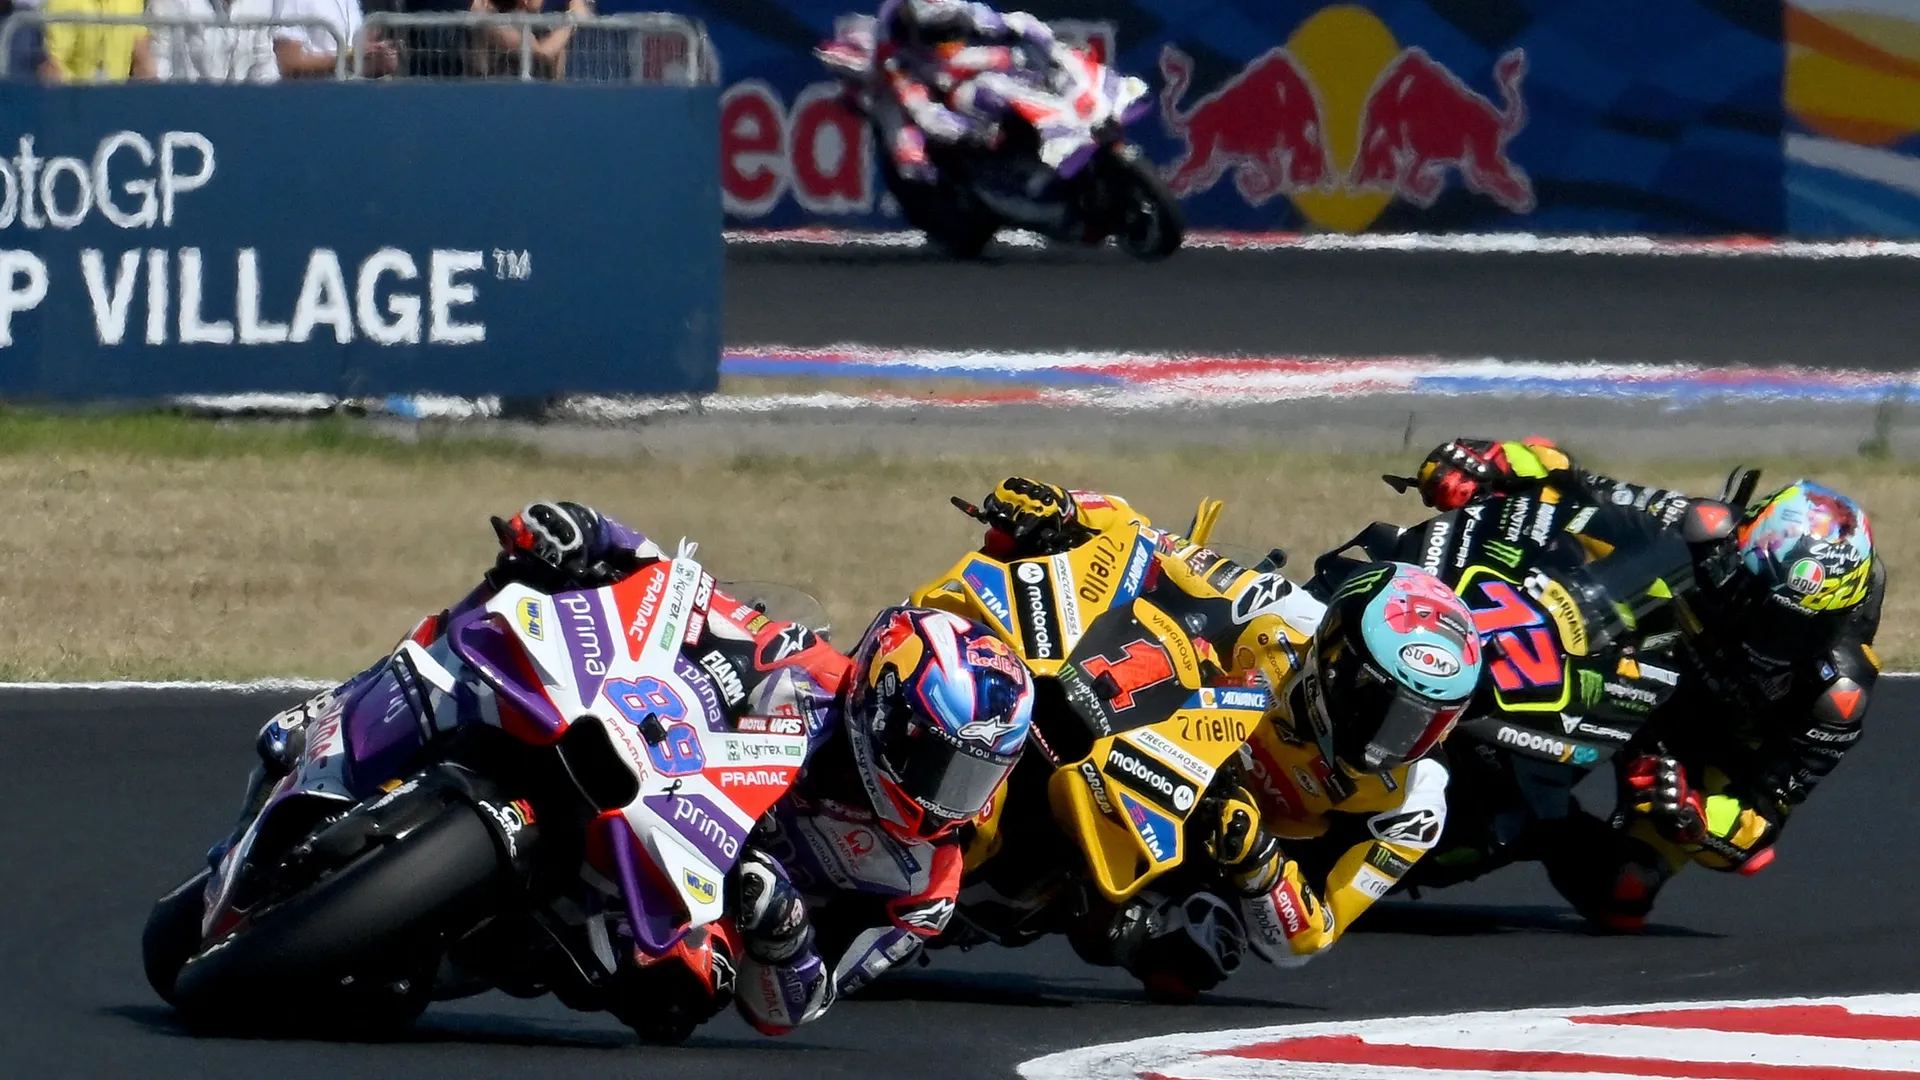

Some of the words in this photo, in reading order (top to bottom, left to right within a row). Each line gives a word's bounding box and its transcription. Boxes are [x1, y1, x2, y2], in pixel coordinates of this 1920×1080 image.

[81, 247, 487, 346] VILLAGE
[1455, 518, 1476, 569] CUPRA
[628, 567, 665, 642] PRAMAC
[980, 587, 1009, 620] TIM
[1058, 558, 1079, 636] FRECCIAROSSA
[1791, 575, 1818, 592] agv
[560, 594, 606, 676] prima
[1027, 585, 1052, 658] motorola
[1466, 579, 1563, 691] 72
[702, 650, 746, 706] FIAMM
[966, 649, 1000, 669] Red
[680, 664, 721, 723] prima
[1072, 677, 1112, 737] MONSTER
[1221, 691, 1266, 708] ADVANCE
[602, 675, 707, 778] 89
[605, 717, 649, 782] PRAMAC
[738, 718, 767, 732] MOTUL
[769, 718, 803, 734] WRS
[742, 741, 784, 759] kyrrex
[969, 744, 990, 758] YOU
[720, 771, 789, 788] PRAMAC
[1108, 749, 1174, 797] motorola
[1138, 731, 1210, 778] FRECCIAROSSA
[674, 797, 739, 859] prima
[1141, 822, 1164, 860] TIM
[686, 872, 714, 897] WD-40
[1275, 881, 1299, 933] Lenovo
